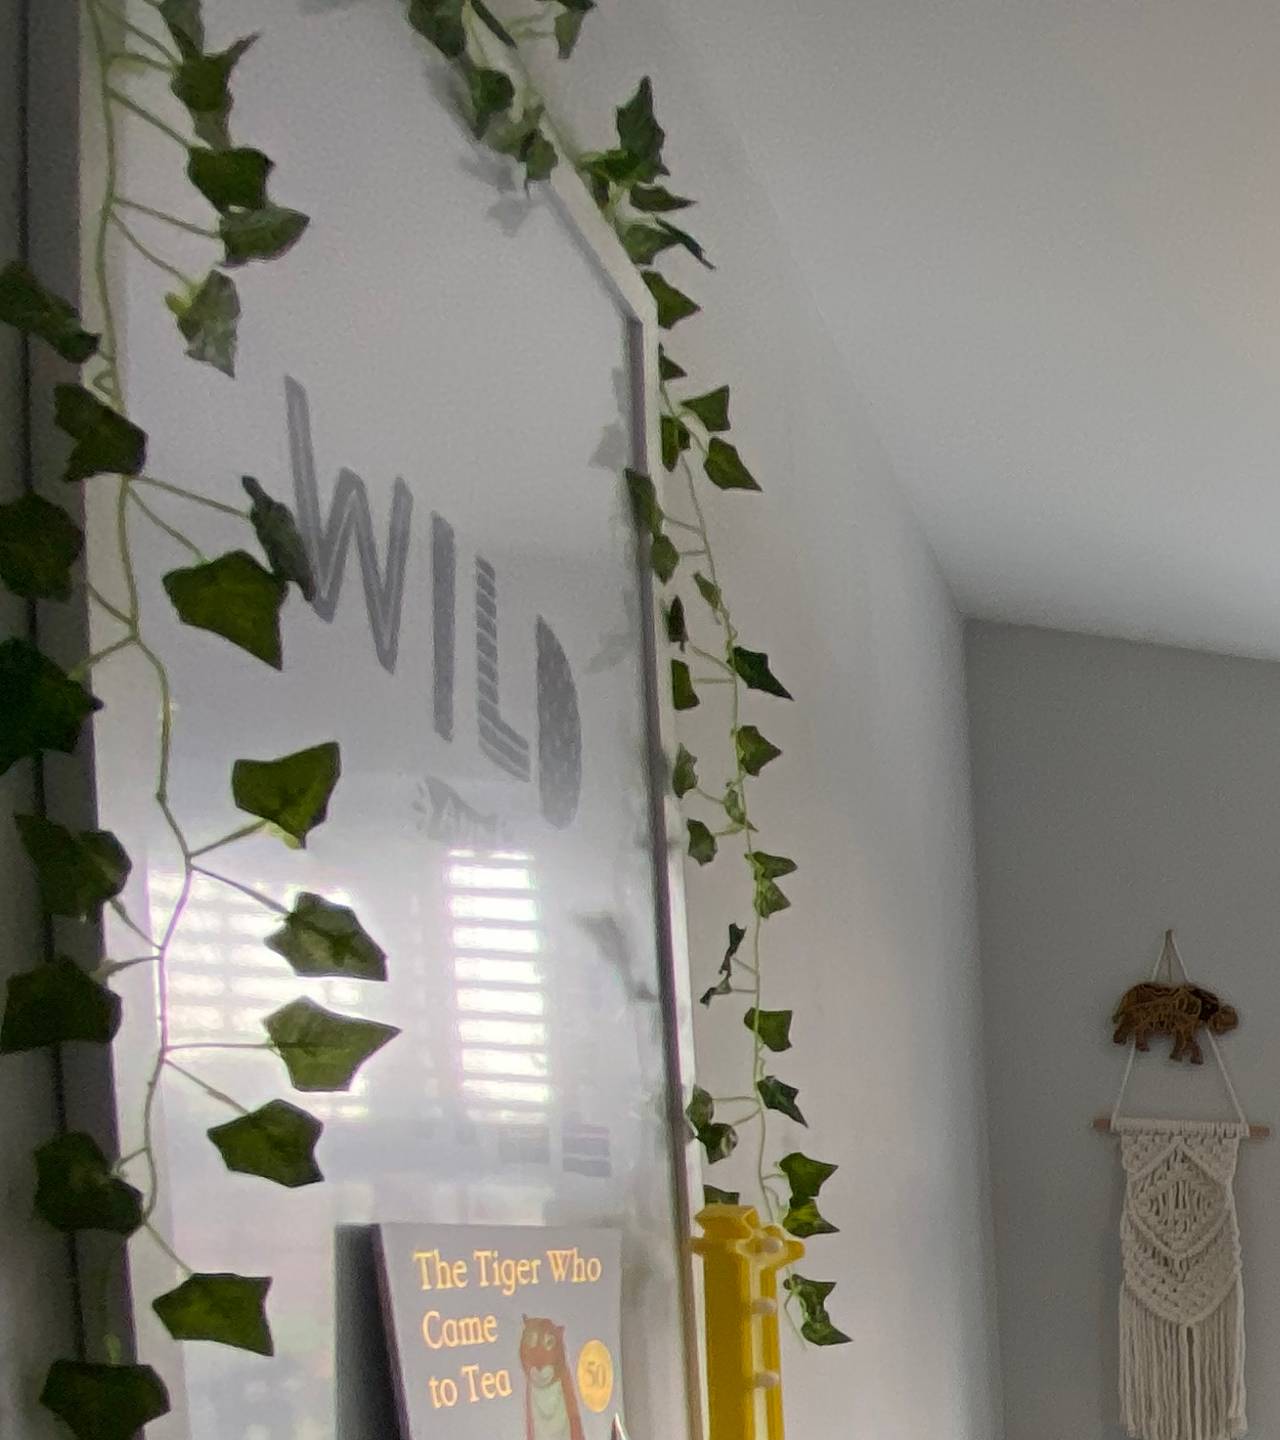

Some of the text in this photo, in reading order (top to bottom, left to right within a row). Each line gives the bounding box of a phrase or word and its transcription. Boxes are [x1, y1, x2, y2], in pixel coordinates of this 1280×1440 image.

[284, 374, 583, 830] WILD
[413, 1247, 602, 1296] The Tiger Who
[422, 1310, 498, 1349] Came
[428, 1363, 513, 1408] to Tea
[585, 1360, 608, 1391] 50
